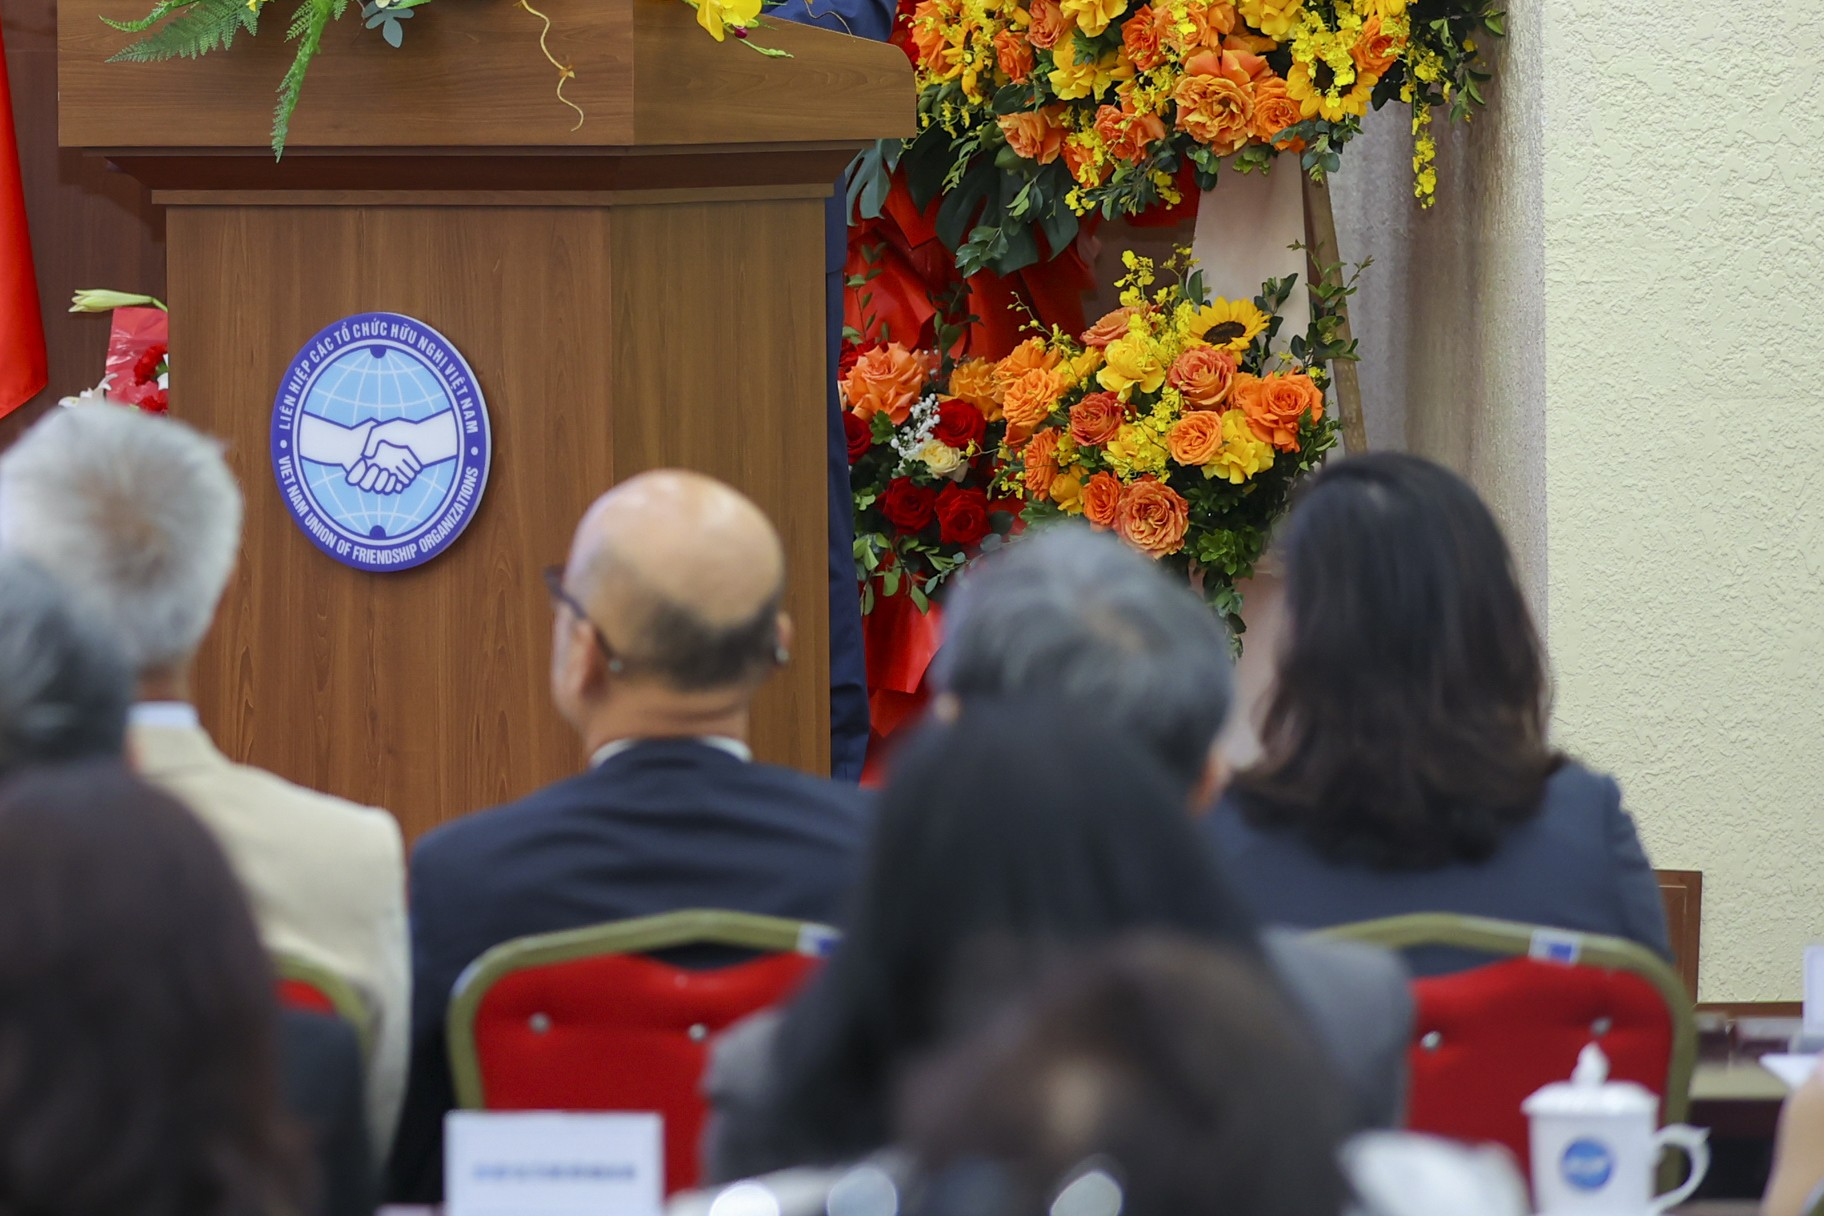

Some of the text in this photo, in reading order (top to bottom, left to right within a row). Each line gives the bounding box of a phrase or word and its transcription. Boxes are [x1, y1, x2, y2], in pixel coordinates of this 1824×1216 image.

[279, 317, 479, 434] LIÊN HIỆP CÁC TỔ CHỨC HỮU NGHỊ VIỆT NAM
[278, 455, 479, 565] VIET NAM UNION OF FRIENDSHIP ORGANIZATIONS
